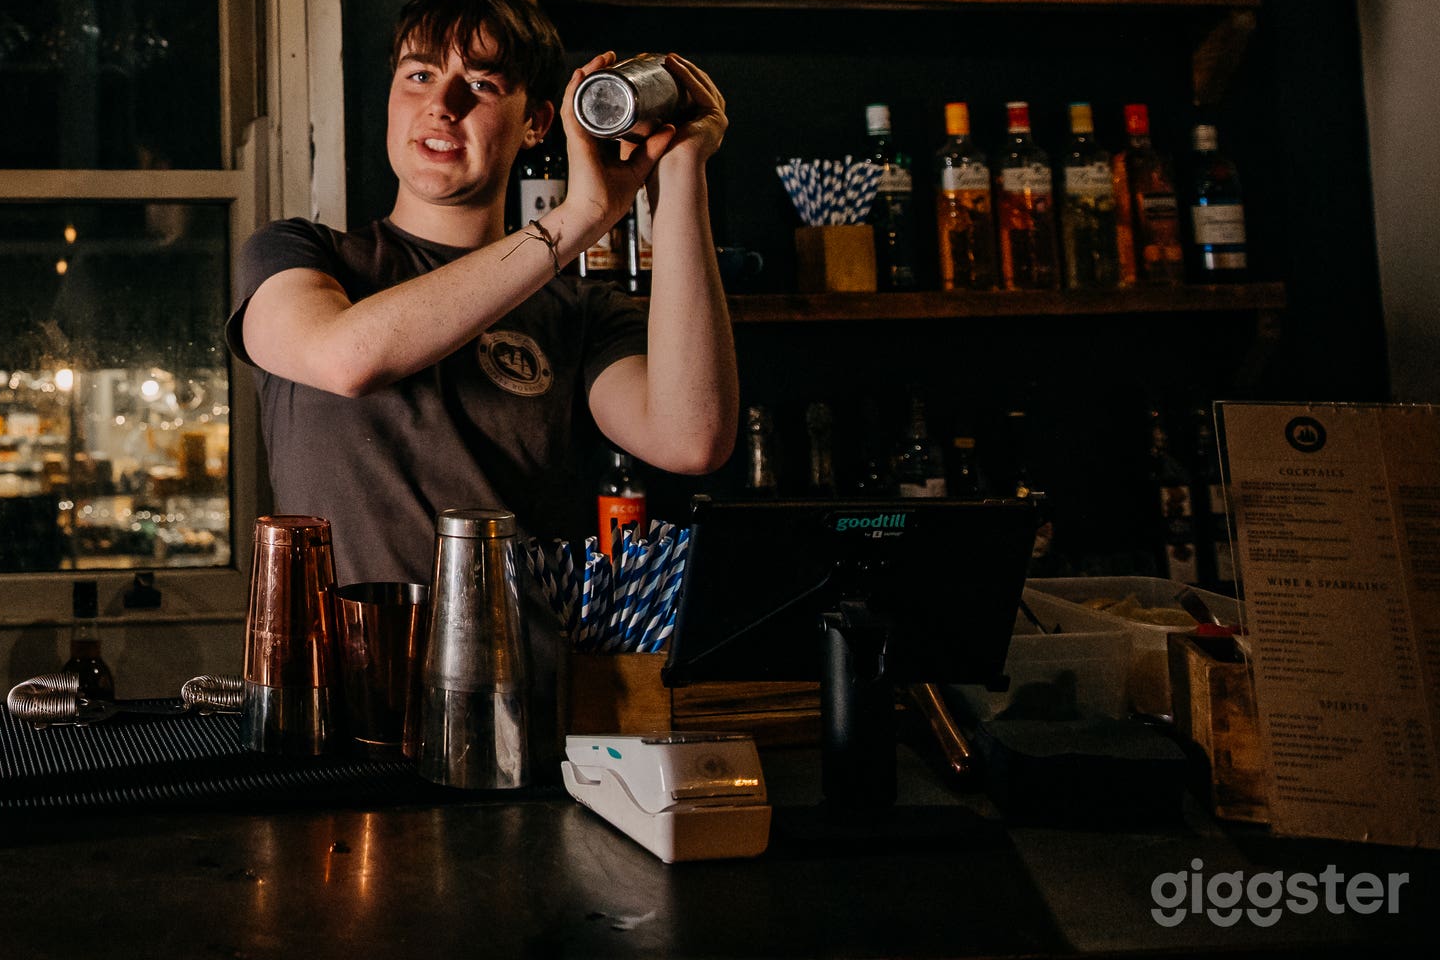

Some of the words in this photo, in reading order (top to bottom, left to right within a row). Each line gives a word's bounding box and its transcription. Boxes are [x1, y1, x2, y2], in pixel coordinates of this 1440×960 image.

[1279, 468, 1345, 478] COCKTAILS
[835, 514, 907, 532] goodtill
[1267, 577, 1299, 587] WINE
[1318, 578, 1388, 590] SPARKLING
